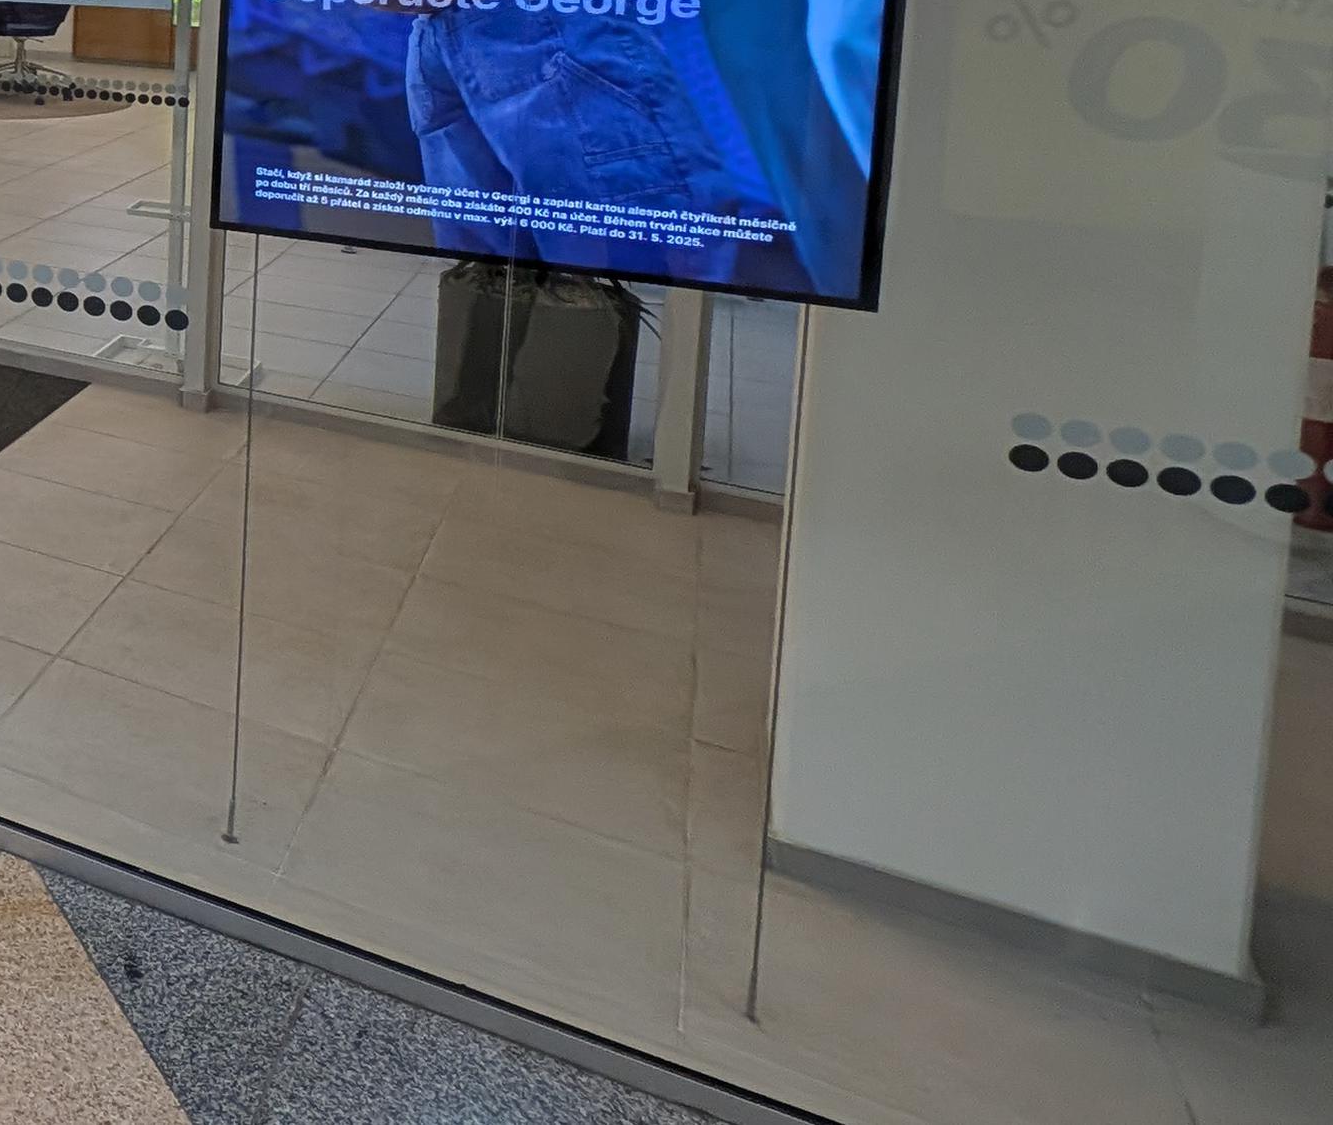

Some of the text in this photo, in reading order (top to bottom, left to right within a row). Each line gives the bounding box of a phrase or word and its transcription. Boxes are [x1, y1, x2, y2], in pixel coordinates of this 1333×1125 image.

[255, 178, 773, 242] po dobu tří měsíců. Za každý měsíc oba získáte 400 Kč na účet. Během trvání akce můžete
[255, 189, 305, 202] doporučit
[306, 195, 318, 204] až
[330, 197, 361, 209] přátel
[372, 202, 405, 213] získat
[406, 206, 452, 219] odměnu
[463, 213, 491, 223] max.
[494, 215, 517, 226] výši
[519, 218, 528, 227] 6
[531, 219, 555, 230] 000
[558, 222, 577, 233] Kč.
[580, 225, 608, 236] Platí
[609, 229, 626, 238] do
[629, 230, 647, 240] 31.
[651, 233, 663, 243] 5.
[667, 235, 705, 247] 2025.
[256, 167, 284, 179] Stačí,
[288, 170, 312, 181] když
[314, 173, 324, 181] si
[325, 174, 371, 187] kamarád
[373, 180, 404, 190] založí
[407, 184, 452, 197] vybraný
[454, 188, 480, 198] účet
[492, 192, 530, 205] Georgi
[543, 198, 583, 209] zaplatí
[585, 201, 625, 213] kartou
[627, 206, 677, 220] alespoň
[680, 210, 736, 225] čtyřikrát
[739, 217, 797, 232] měsíčně
